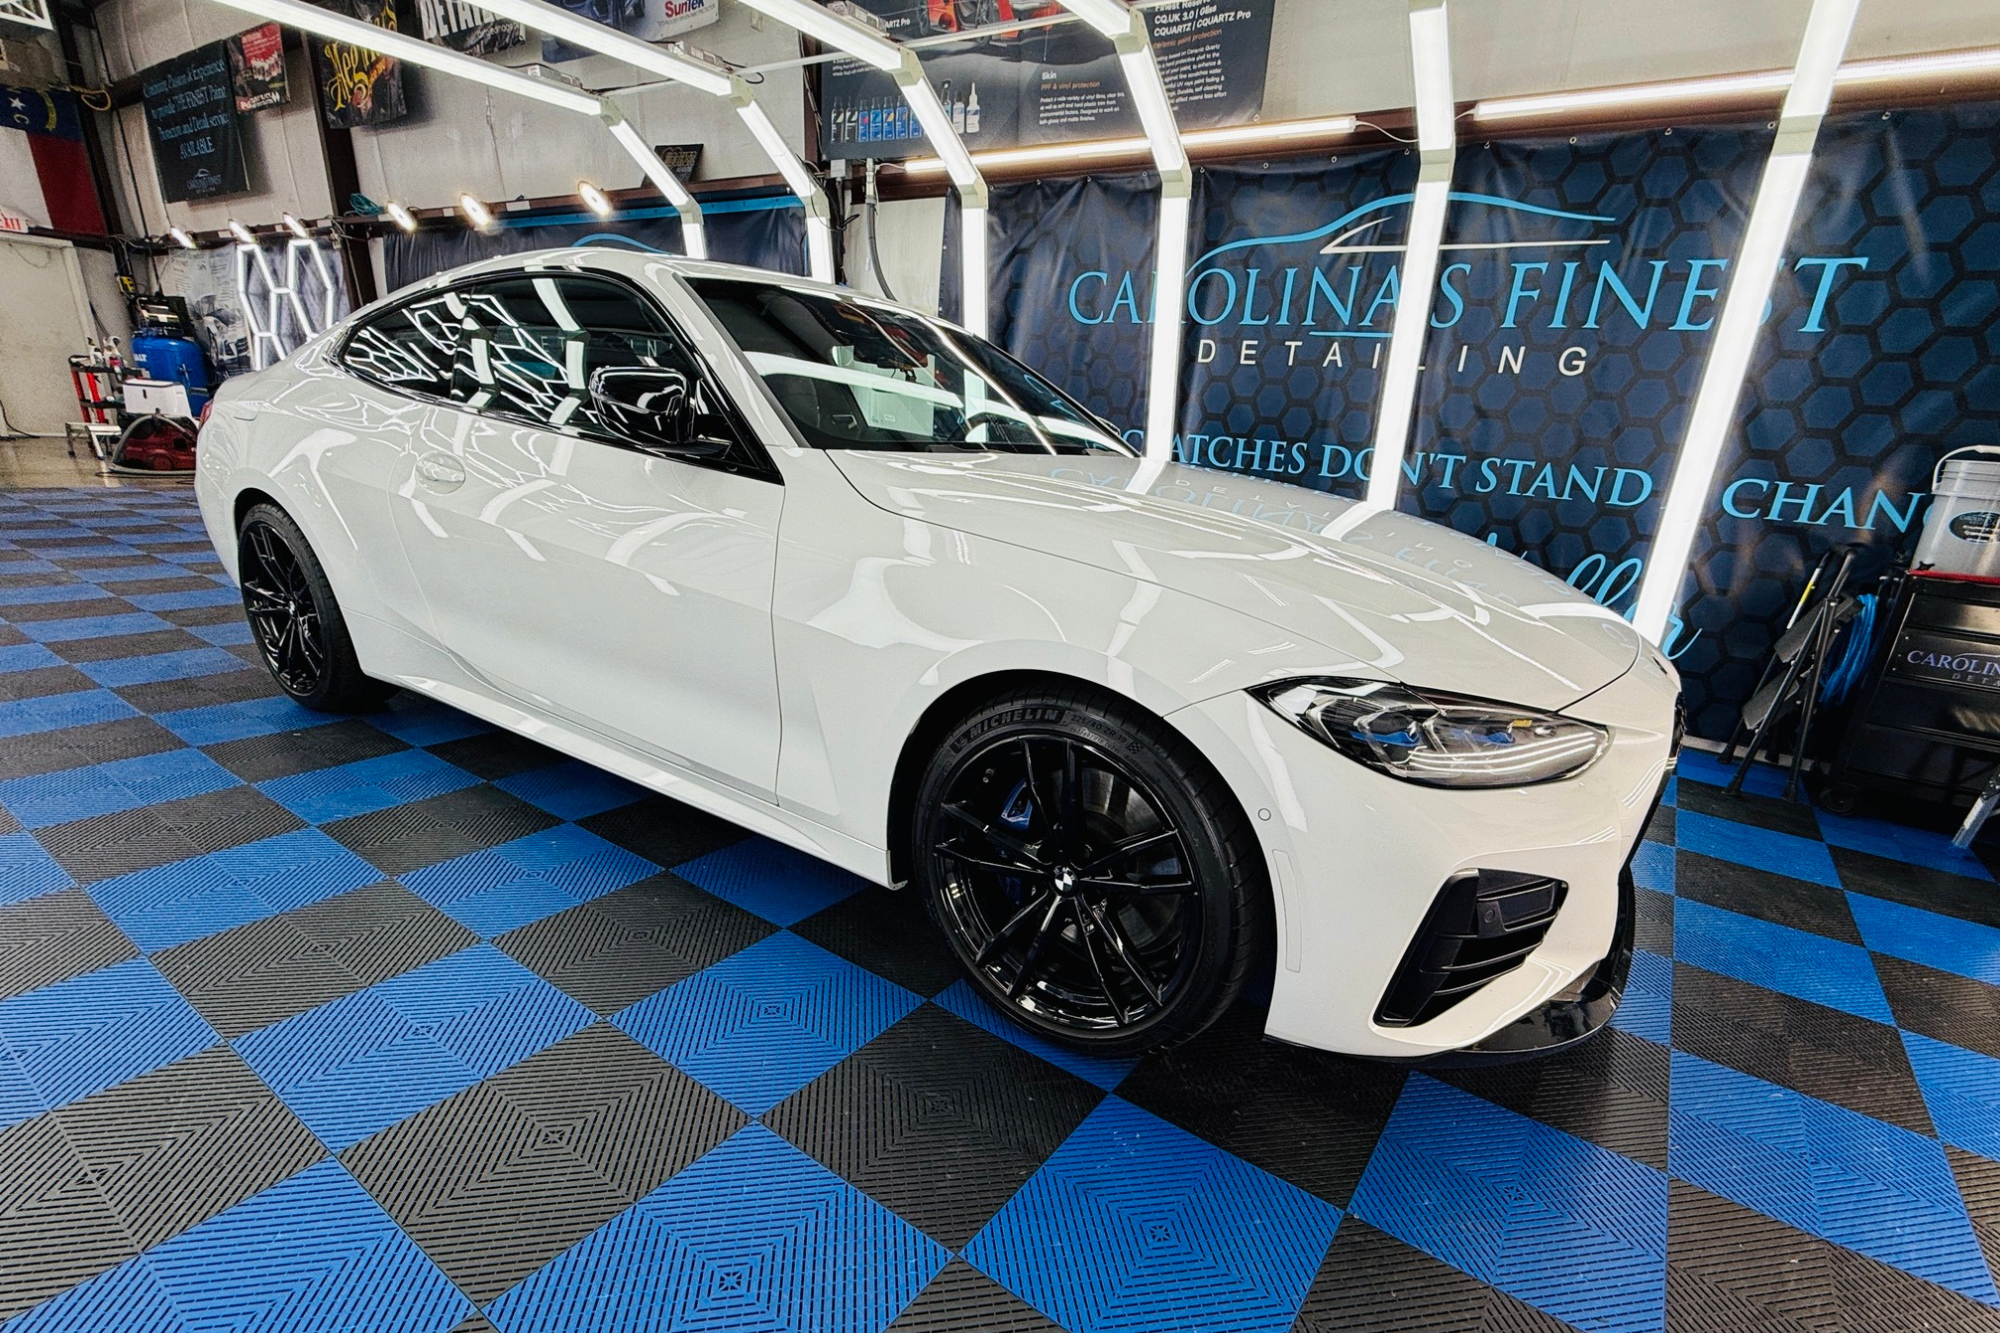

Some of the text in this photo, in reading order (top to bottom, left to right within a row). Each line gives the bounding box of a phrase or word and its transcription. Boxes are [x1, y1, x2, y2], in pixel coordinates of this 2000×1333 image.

[1154, 22, 1191, 37] CQUARTZ
[1197, 12, 1235, 27] CQUARTZ
[1236, 10, 1252, 20] Pro
[1182, 11, 1195, 20] 3.0
[1200, 4, 1217, 17] Gliss
[1192, 28, 1222, 41] protection
[1041, 70, 1057, 80] Skin
[1072, 81, 1100, 89] protection
[1069, 256, 1869, 333] CAOLINAS FINET
[1197, 339, 1588, 376] DETAIING
[1475, 456, 1654, 508] STAND
[1722, 478, 1933, 534] CHAN
[969, 708, 1059, 738] MICHELIN
[1070, 714, 1102, 730] 225/40
[1103, 725, 1117, 738] ZR
[1116, 731, 1128, 743] 19
